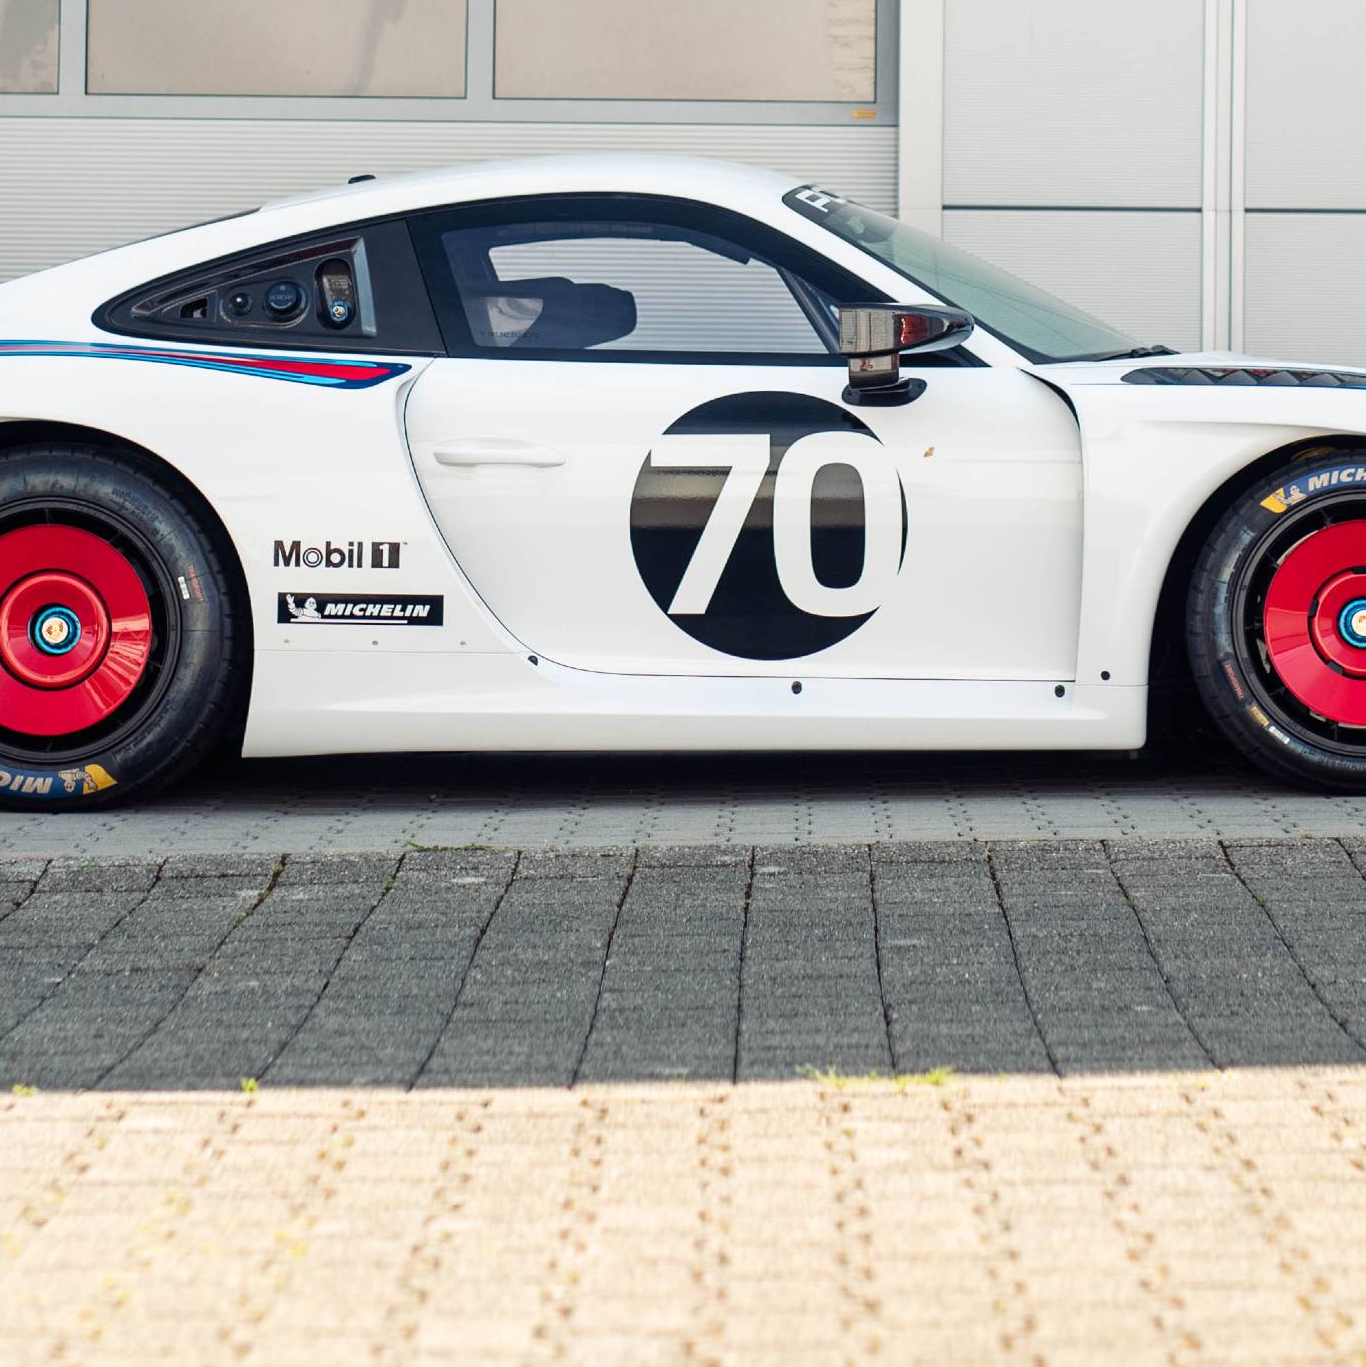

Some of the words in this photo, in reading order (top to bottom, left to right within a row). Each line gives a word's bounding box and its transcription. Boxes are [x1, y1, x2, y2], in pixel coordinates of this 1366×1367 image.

[650, 430, 902, 617] 70
[273, 540, 363, 568] Mobil
[323, 602, 431, 618] MICHELIN
